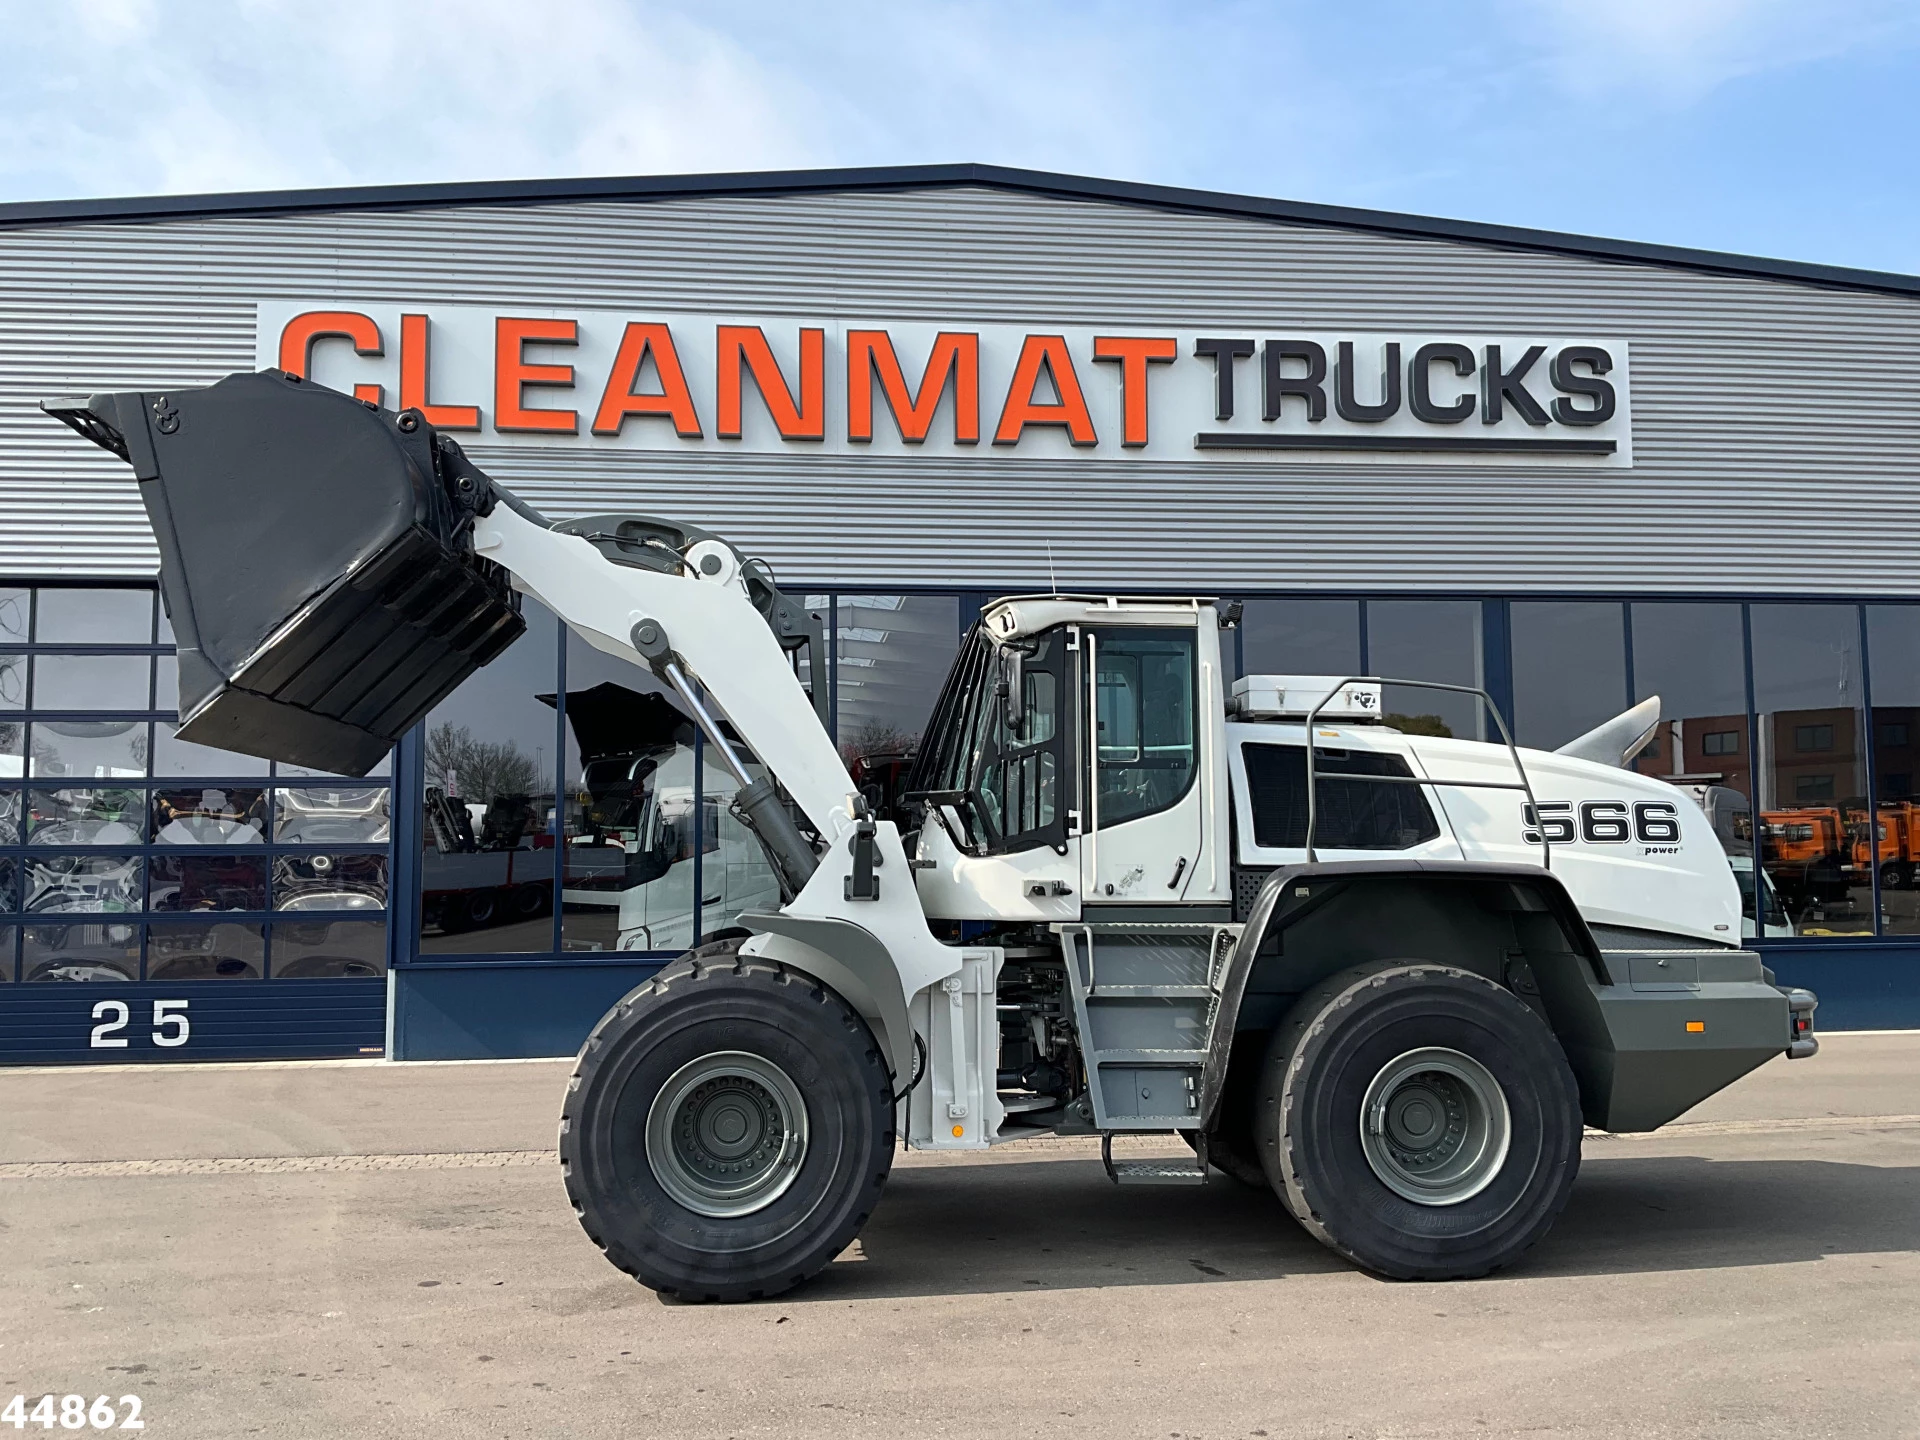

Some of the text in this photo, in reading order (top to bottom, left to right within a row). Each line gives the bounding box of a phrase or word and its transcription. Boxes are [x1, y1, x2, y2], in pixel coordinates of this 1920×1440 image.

[279, 311, 1617, 447] CLEANMAT TRUCKS
[1521, 800, 1682, 845] 566
